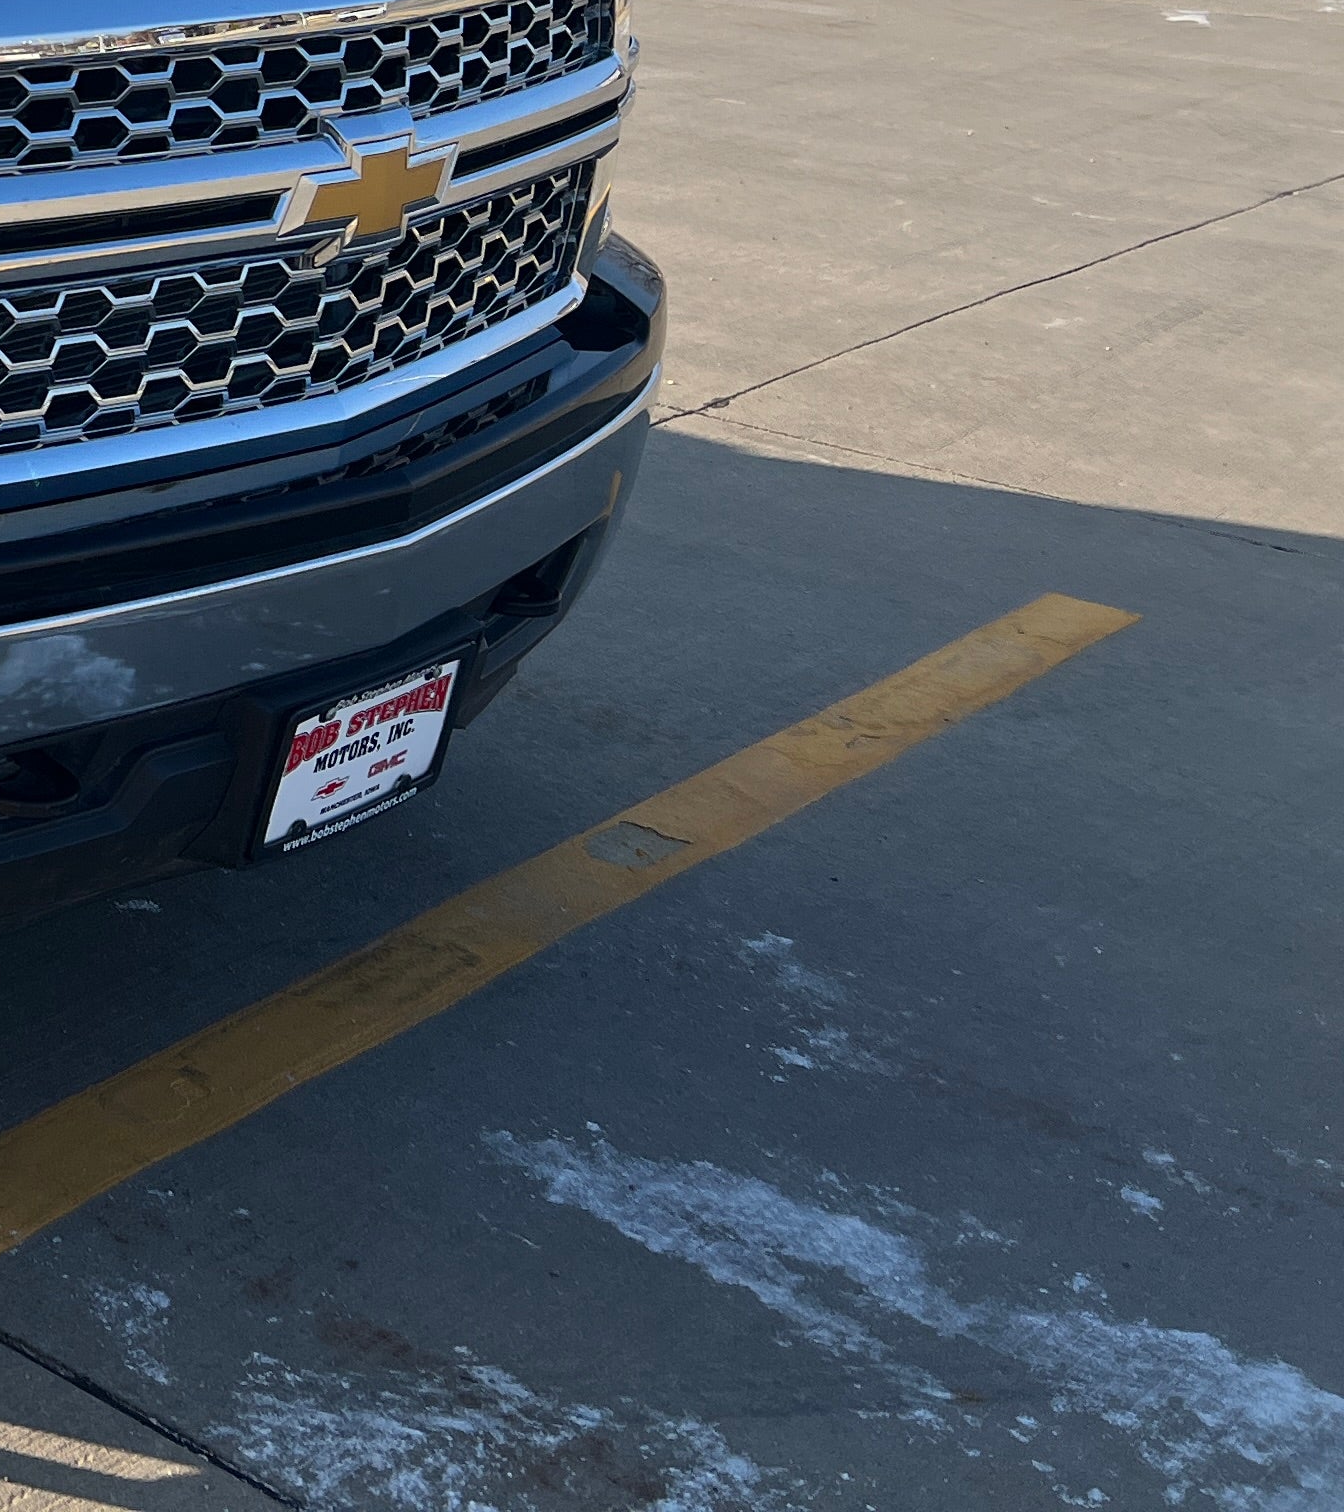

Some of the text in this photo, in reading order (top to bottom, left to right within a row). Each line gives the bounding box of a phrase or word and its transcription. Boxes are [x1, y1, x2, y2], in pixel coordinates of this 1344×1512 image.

[282, 672, 452, 777] BOB STEPHEN
[313, 719, 415, 774] MOTORS, INC.
[368, 749, 409, 778] GMC
[282, 786, 418, 852] www.bobstephenmotors.com
